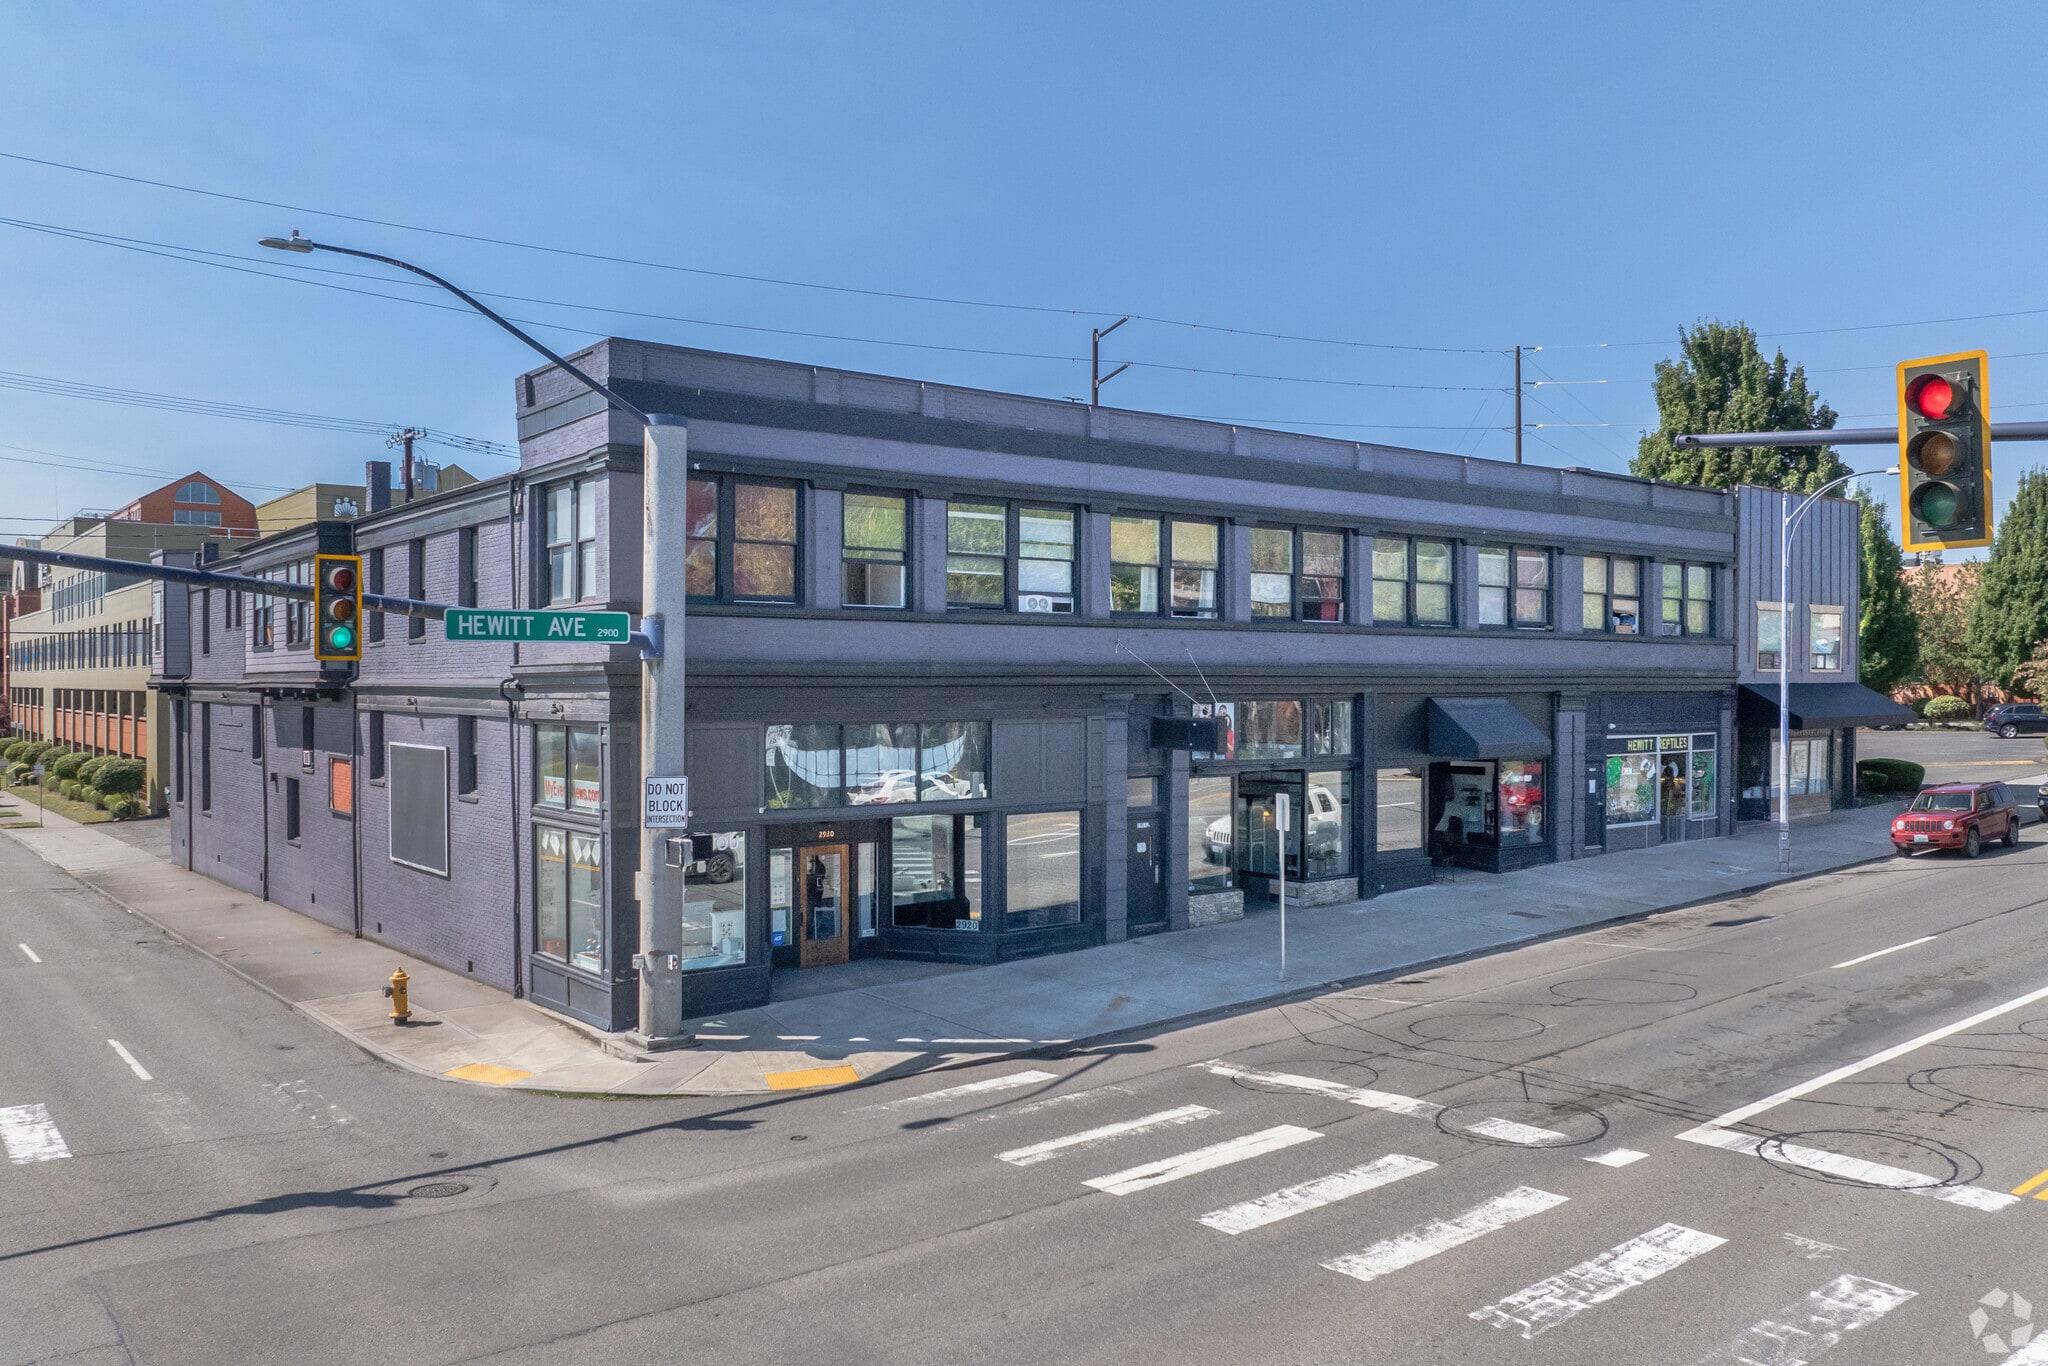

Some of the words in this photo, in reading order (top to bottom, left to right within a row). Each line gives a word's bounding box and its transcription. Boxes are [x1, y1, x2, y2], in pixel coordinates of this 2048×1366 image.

[458, 615, 534, 636] HEWITT
[547, 617, 586, 637] AVE
[597, 628, 619, 638] 2900
[1627, 739, 1653, 751] HEWITT
[1660, 737, 1687, 749] REPTILES
[648, 783, 662, 795] DO
[665, 783, 685, 795] NOT
[648, 800, 683, 812] BLOCK
[646, 814, 685, 824] INTERSECTION
[818, 830, 835, 838] 2920
[956, 920, 978, 930] 2920
